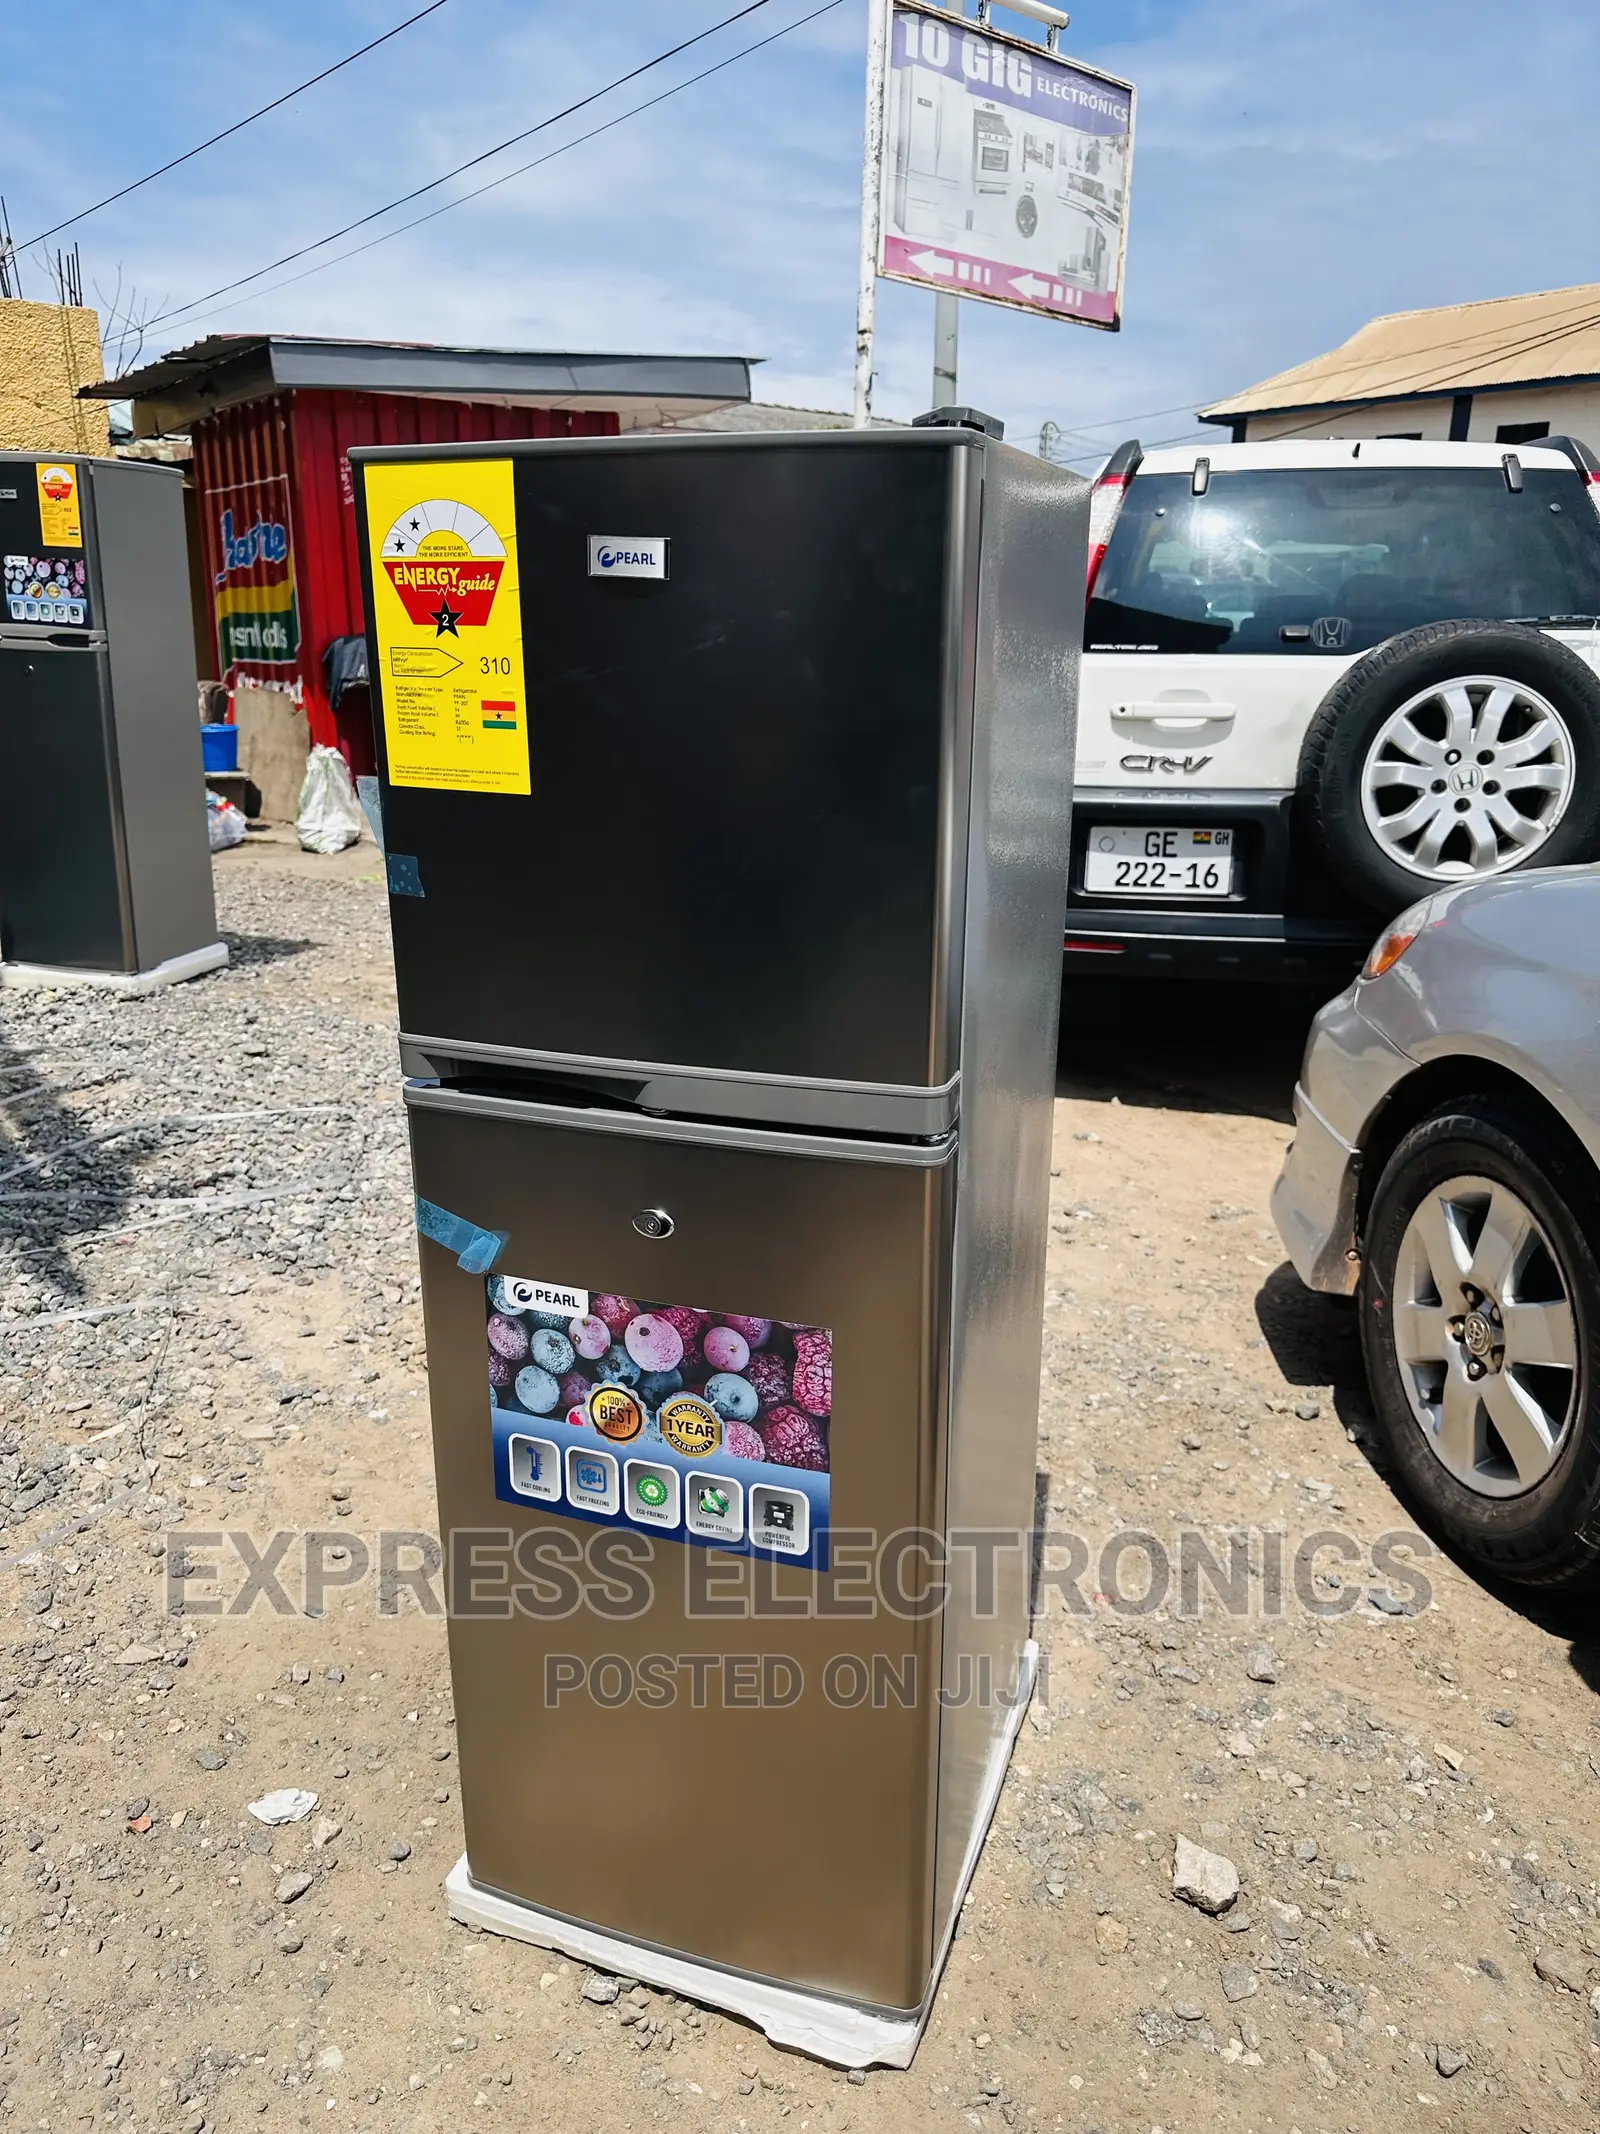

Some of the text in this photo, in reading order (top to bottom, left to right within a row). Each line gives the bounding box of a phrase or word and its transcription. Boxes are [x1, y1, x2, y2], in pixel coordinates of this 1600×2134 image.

[898, 13, 949, 67] 10
[1037, 79, 1128, 122] ELECTRONICS
[616, 551, 657, 566] PEARL
[394, 563, 495, 596] ENERGY guide
[442, 614, 449, 626] 2
[480, 656, 511, 675] 310
[1120, 754, 1214, 774] CR-V
[1144, 831, 1230, 857] GE GH
[1115, 861, 1219, 888] 222-16
[535, 1288, 581, 1309] PEARL
[607, 1395, 626, 1408] 100%
[599, 1404, 633, 1425] BEST
[671, 1403, 711, 1422] WARRANTY
[666, 1419, 716, 1439] 1 YEAR
[671, 1434, 711, 1454] WARRANTY
[576, 1494, 610, 1508] FAST FREEZING
